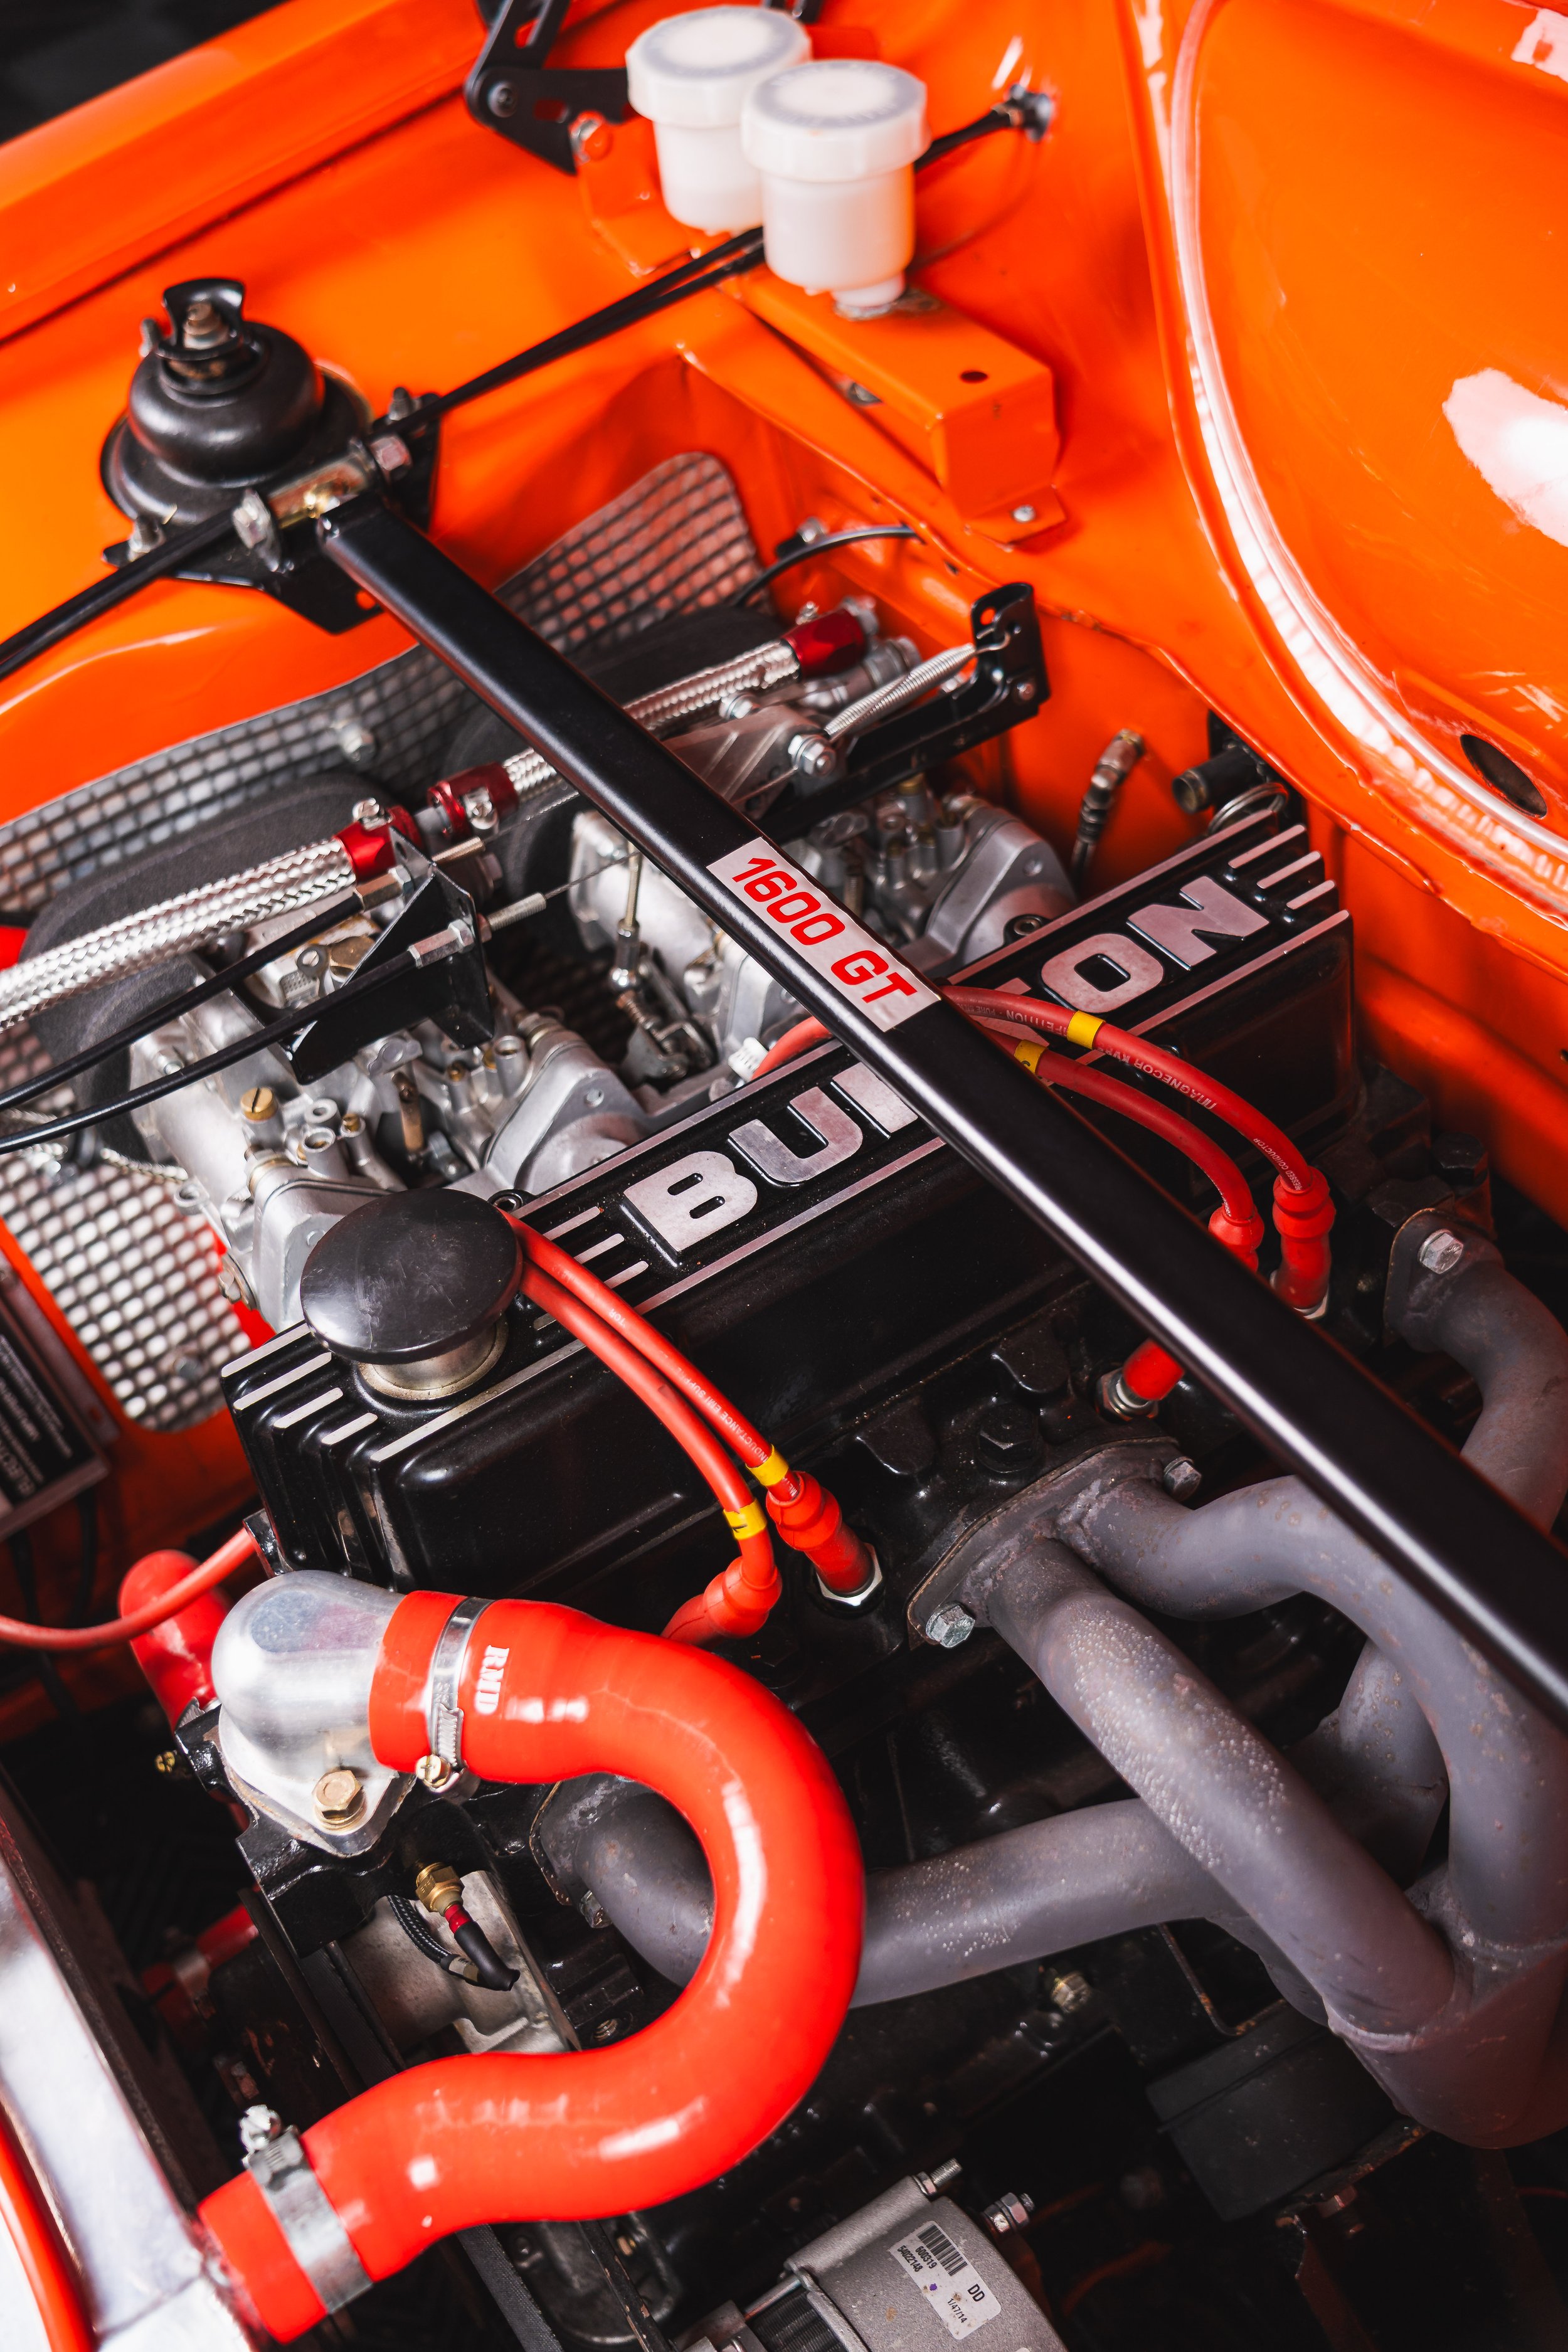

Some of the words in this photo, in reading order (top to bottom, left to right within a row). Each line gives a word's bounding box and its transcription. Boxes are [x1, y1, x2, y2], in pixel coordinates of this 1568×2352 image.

[731, 857, 845, 946] 1600
[830, 950, 918, 1004] GT
[622, 876, 1271, 1253] BUON
[1133, 1058, 1217, 1110] MAGNECOR
[1253, 1138, 1289, 1170] CONDUCTOR
[704, 1396, 722, 1414] EMI
[721, 1411, 769, 1463] INDUCTANCE
[474, 1645, 509, 1714] RMD
[897, 2245, 923, 2272] 54022148
[915, 2245, 938, 2269] 600319
[967, 2283, 985, 2302] DD
[947, 2298, 968, 2323] 1/47/14
